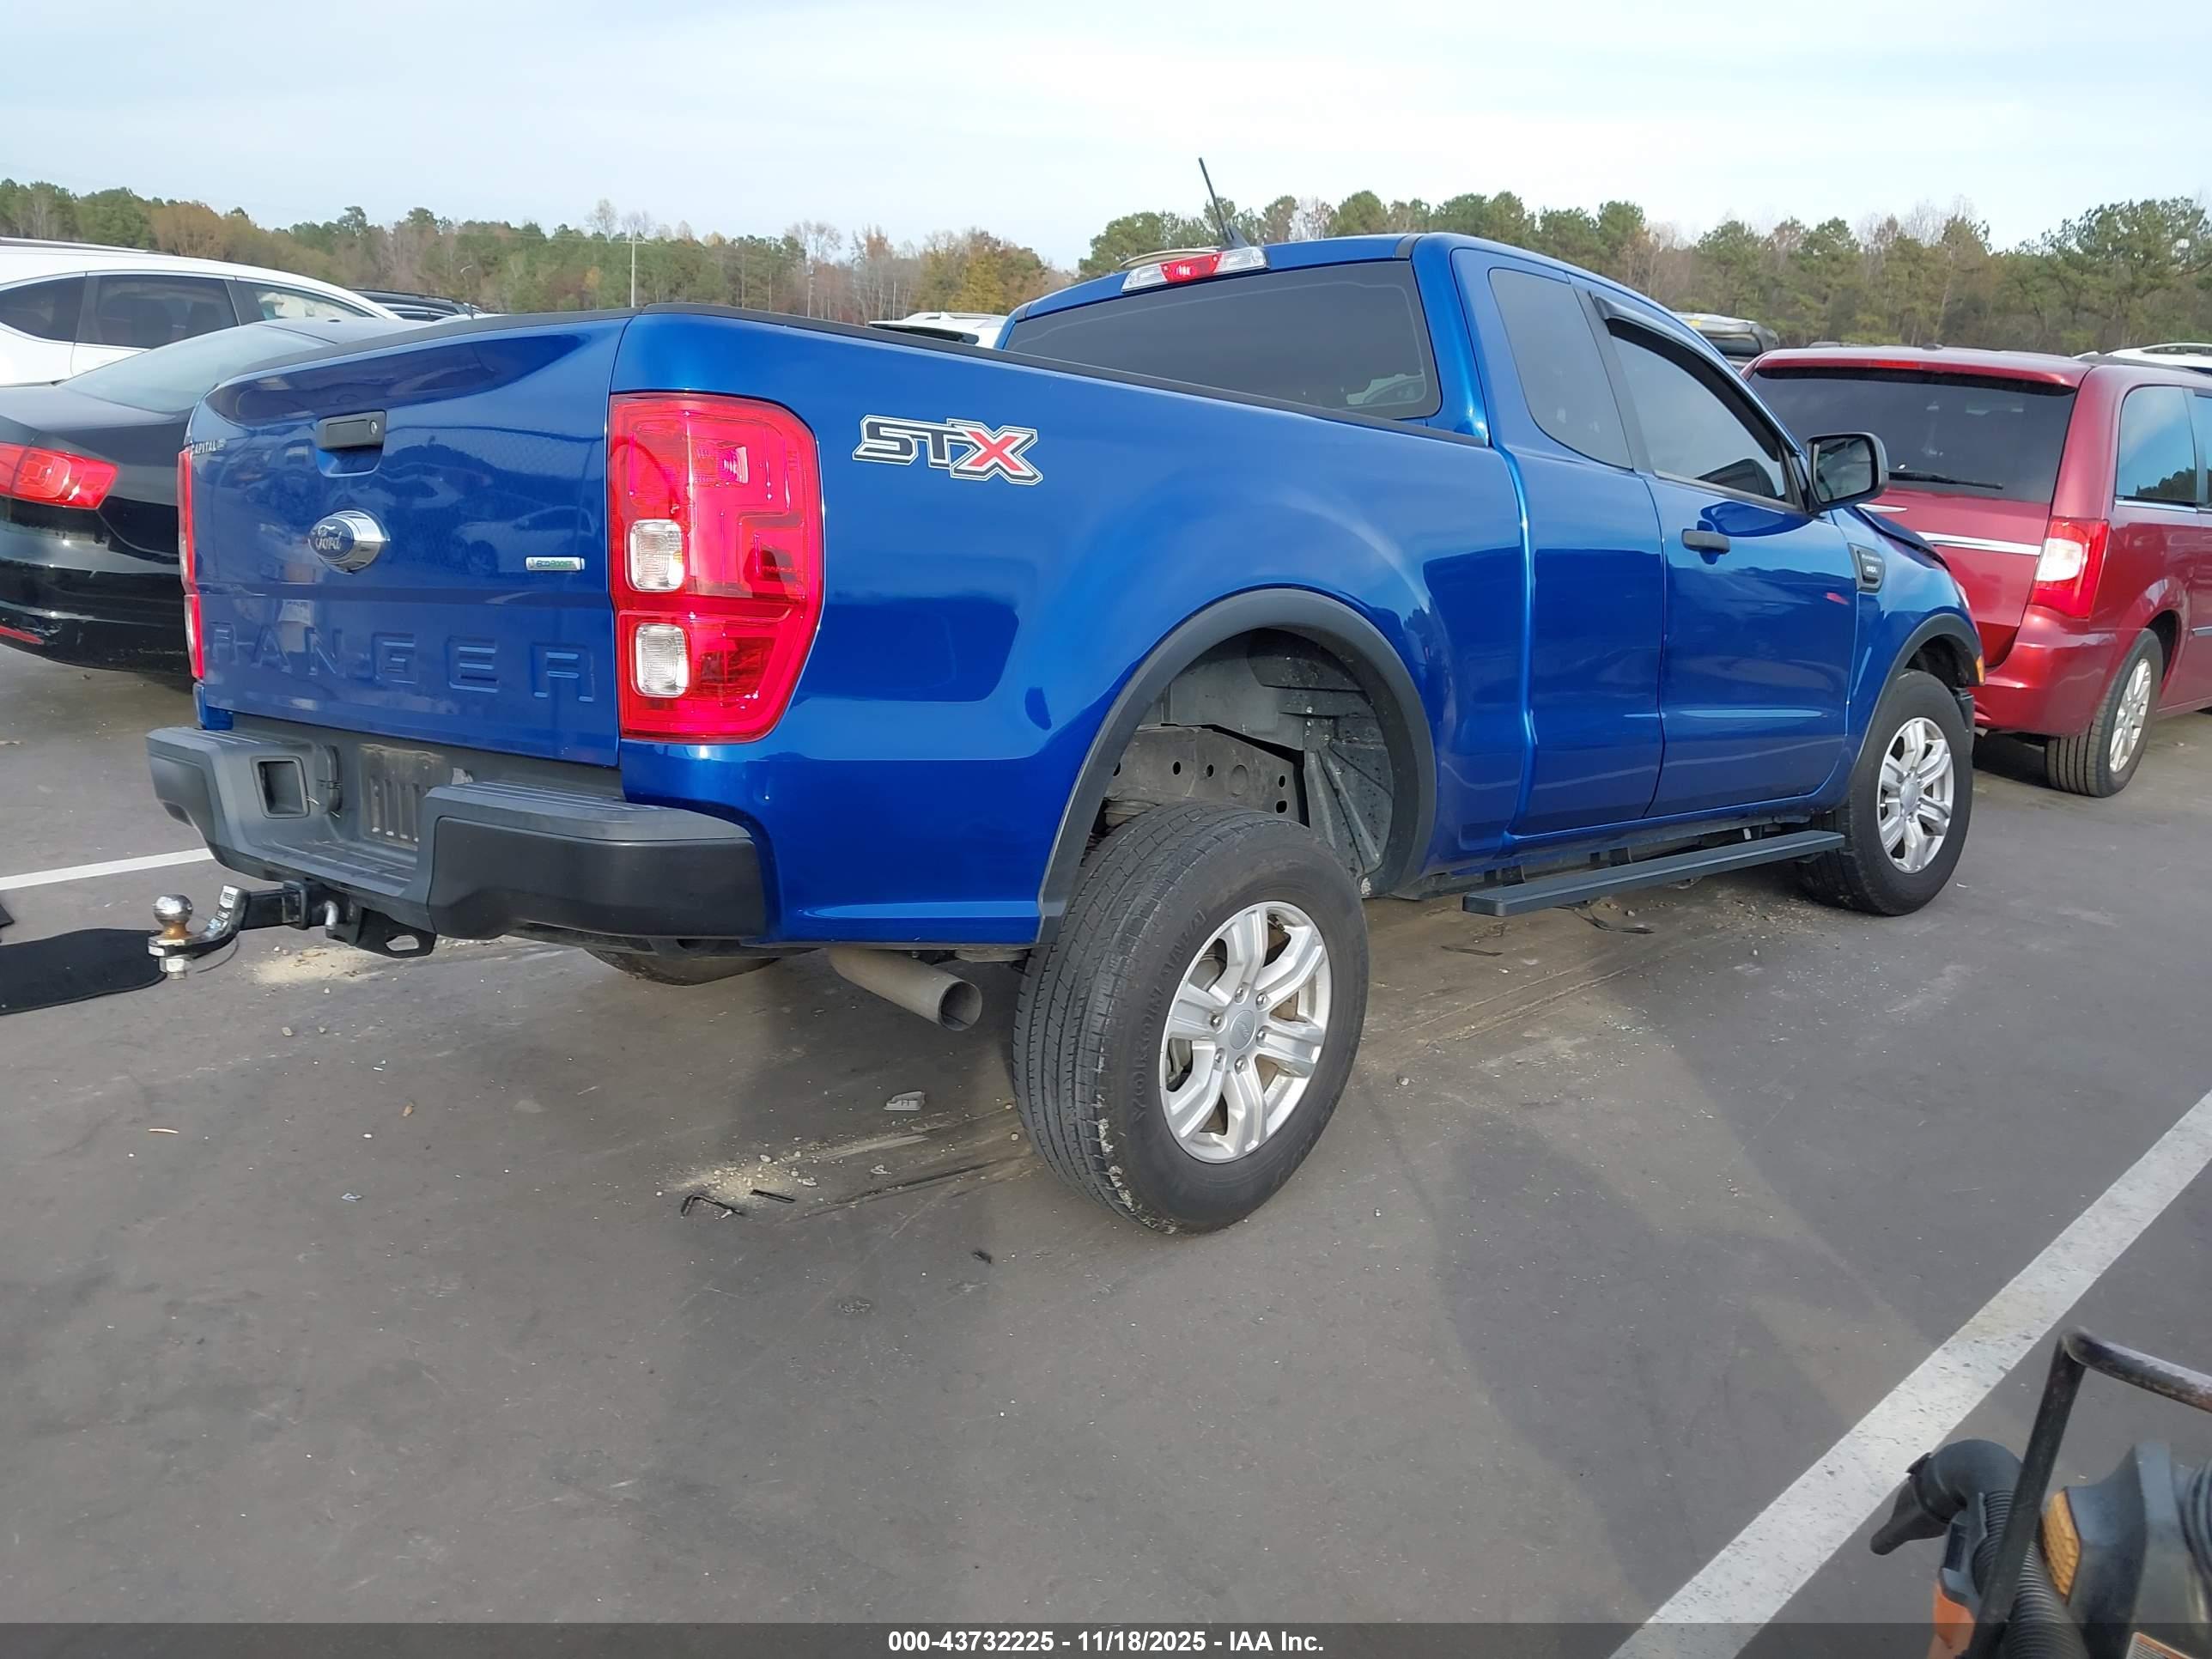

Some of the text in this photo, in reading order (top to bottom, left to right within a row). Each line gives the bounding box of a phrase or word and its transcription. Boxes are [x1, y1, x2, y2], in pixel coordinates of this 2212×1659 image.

[852, 414, 1044, 486] STX
[311, 524, 343, 551] Ford
[208, 620, 596, 702] RANGER
